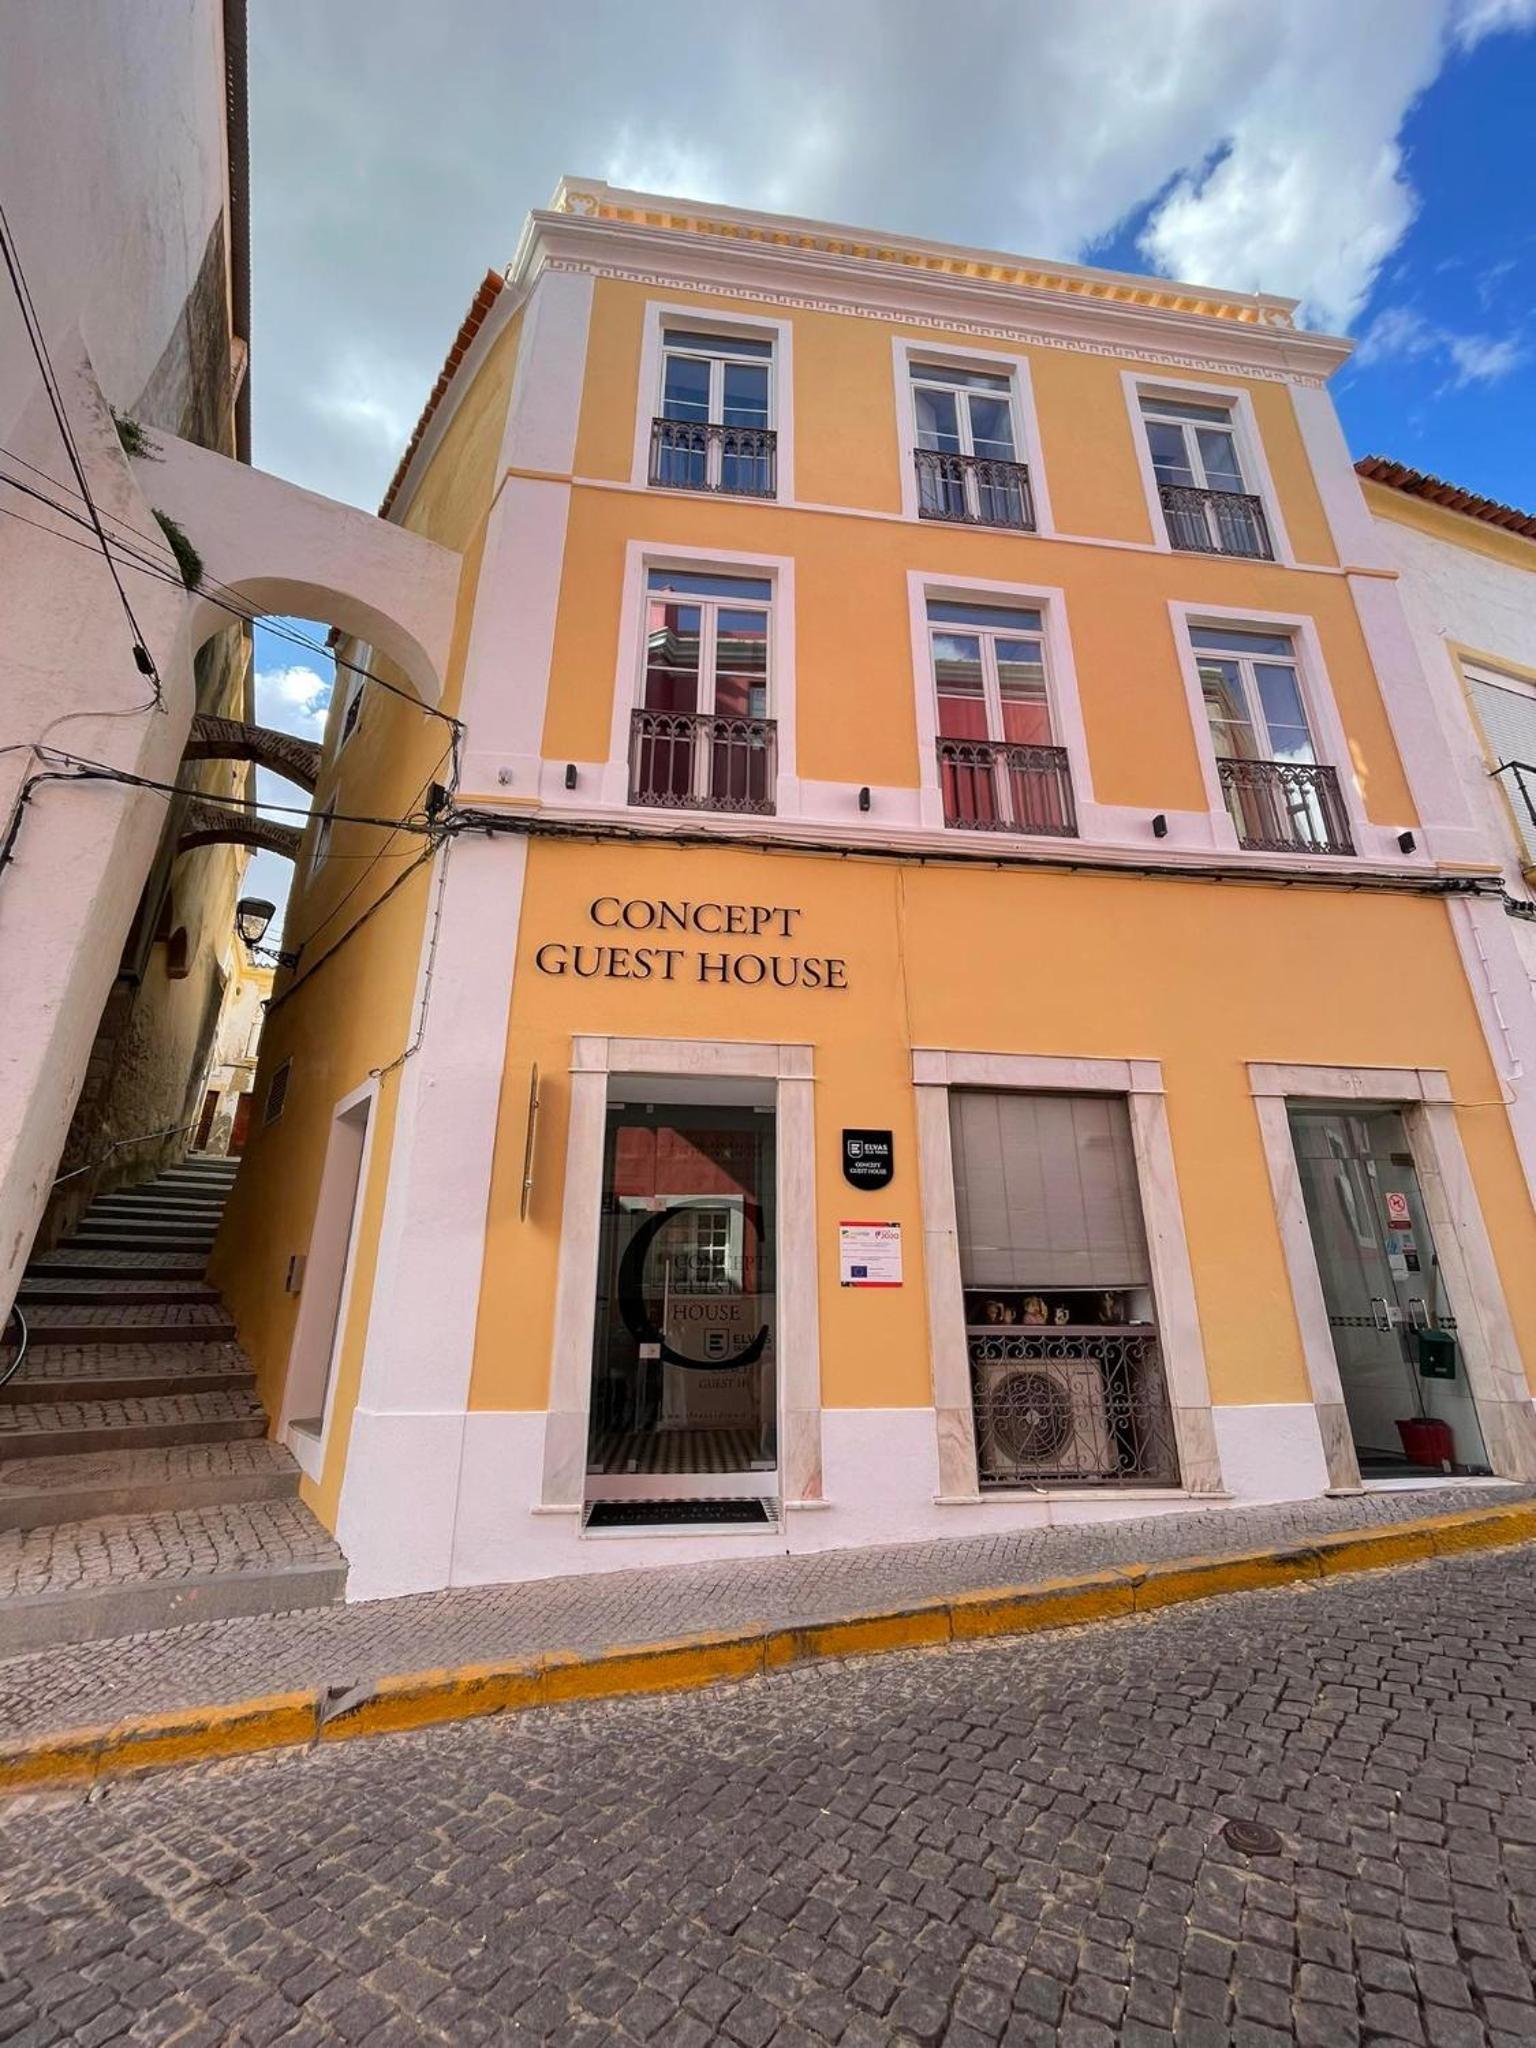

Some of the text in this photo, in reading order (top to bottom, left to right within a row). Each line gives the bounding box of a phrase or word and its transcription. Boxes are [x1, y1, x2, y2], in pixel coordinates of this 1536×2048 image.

[590, 896, 801, 938] CONCEPT
[535, 943, 848, 989] GUEST HOUSE
[864, 1143, 888, 1151] ELVAS
[672, 1304, 741, 1321] HOUSE
[733, 1334, 771, 1345] ELVS
